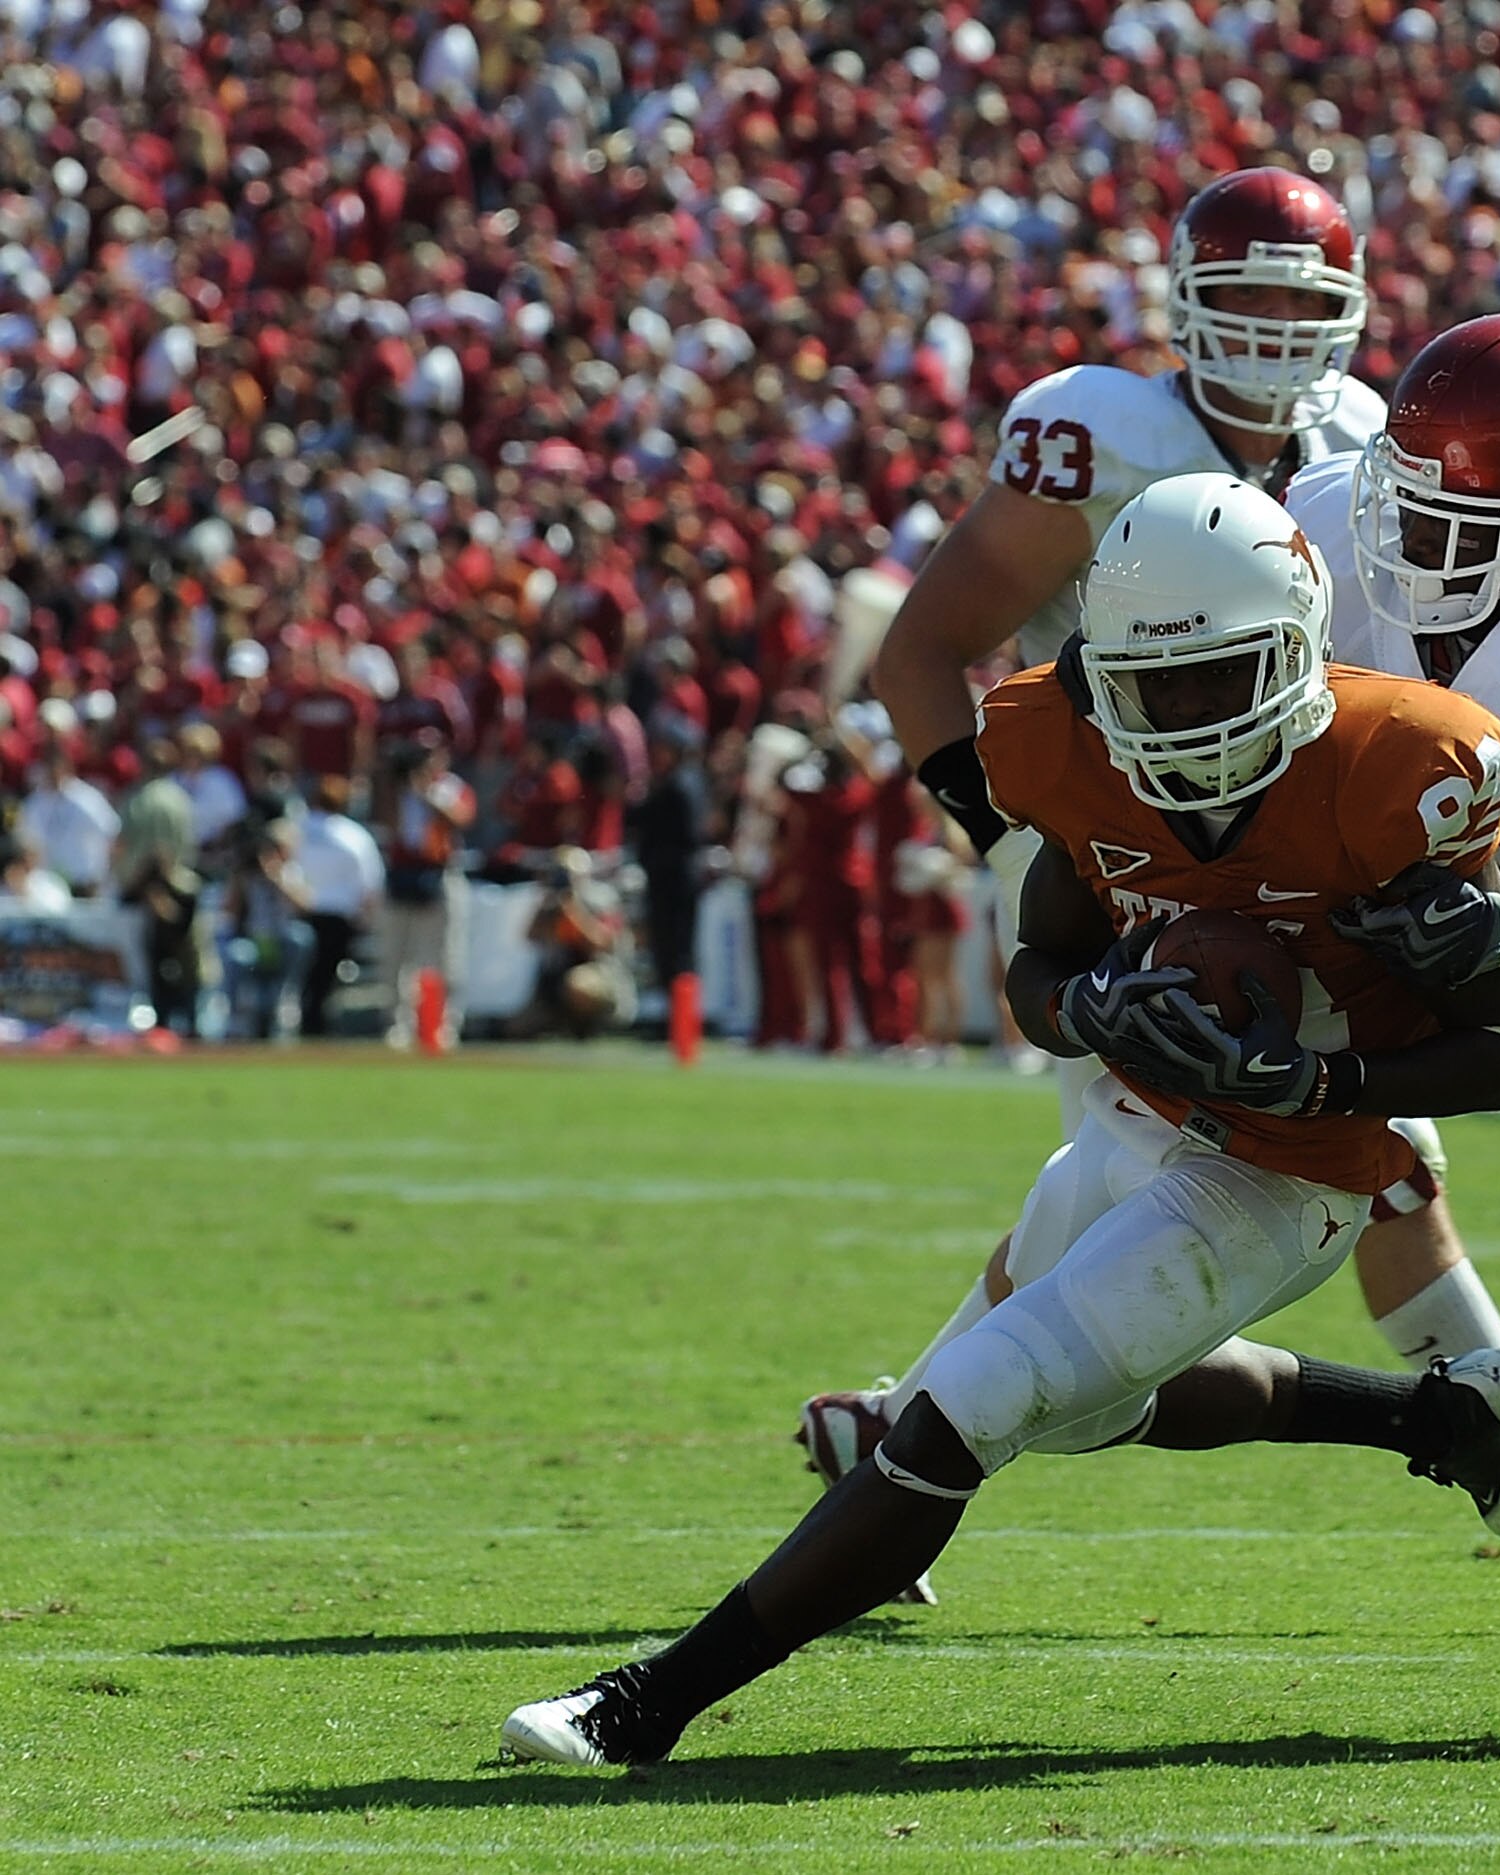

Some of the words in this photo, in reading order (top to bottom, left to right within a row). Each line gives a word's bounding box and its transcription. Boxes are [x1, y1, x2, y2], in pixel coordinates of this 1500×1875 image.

[1004, 417, 1094, 500] 33
[1148, 618, 1192, 638] HORNS
[1190, 1112, 1219, 1140] 42
